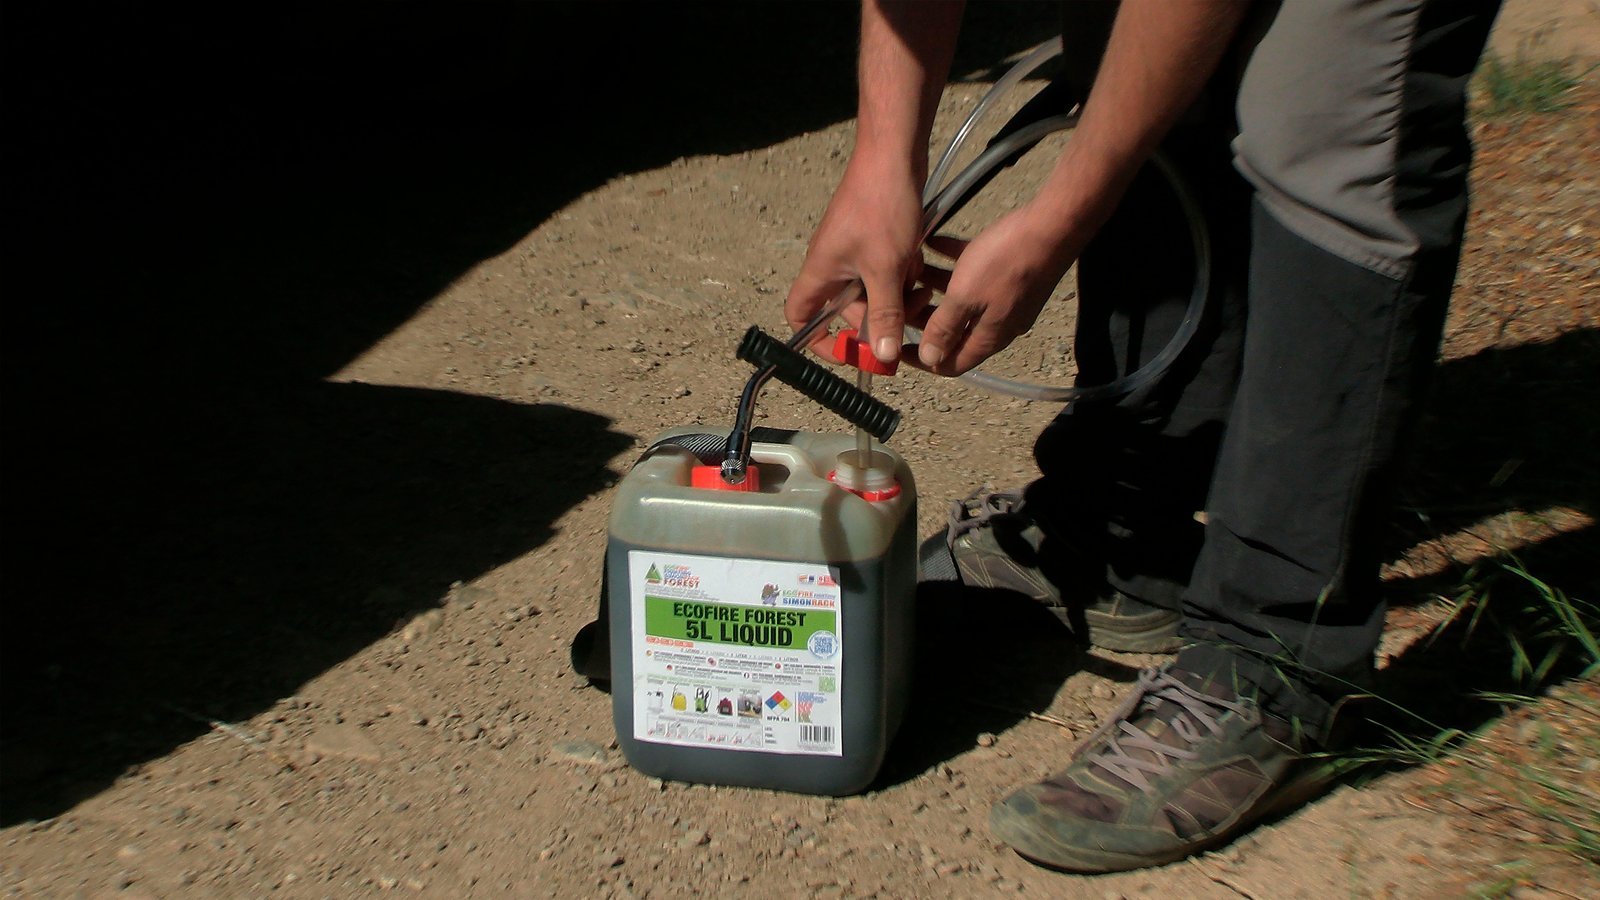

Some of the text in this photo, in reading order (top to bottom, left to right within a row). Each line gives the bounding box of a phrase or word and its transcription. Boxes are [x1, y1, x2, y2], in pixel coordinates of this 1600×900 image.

[673, 602, 806, 627] ECOFIRE FOREST
[686, 620, 713, 640] 5L
[720, 622, 793, 646] LIQUID
